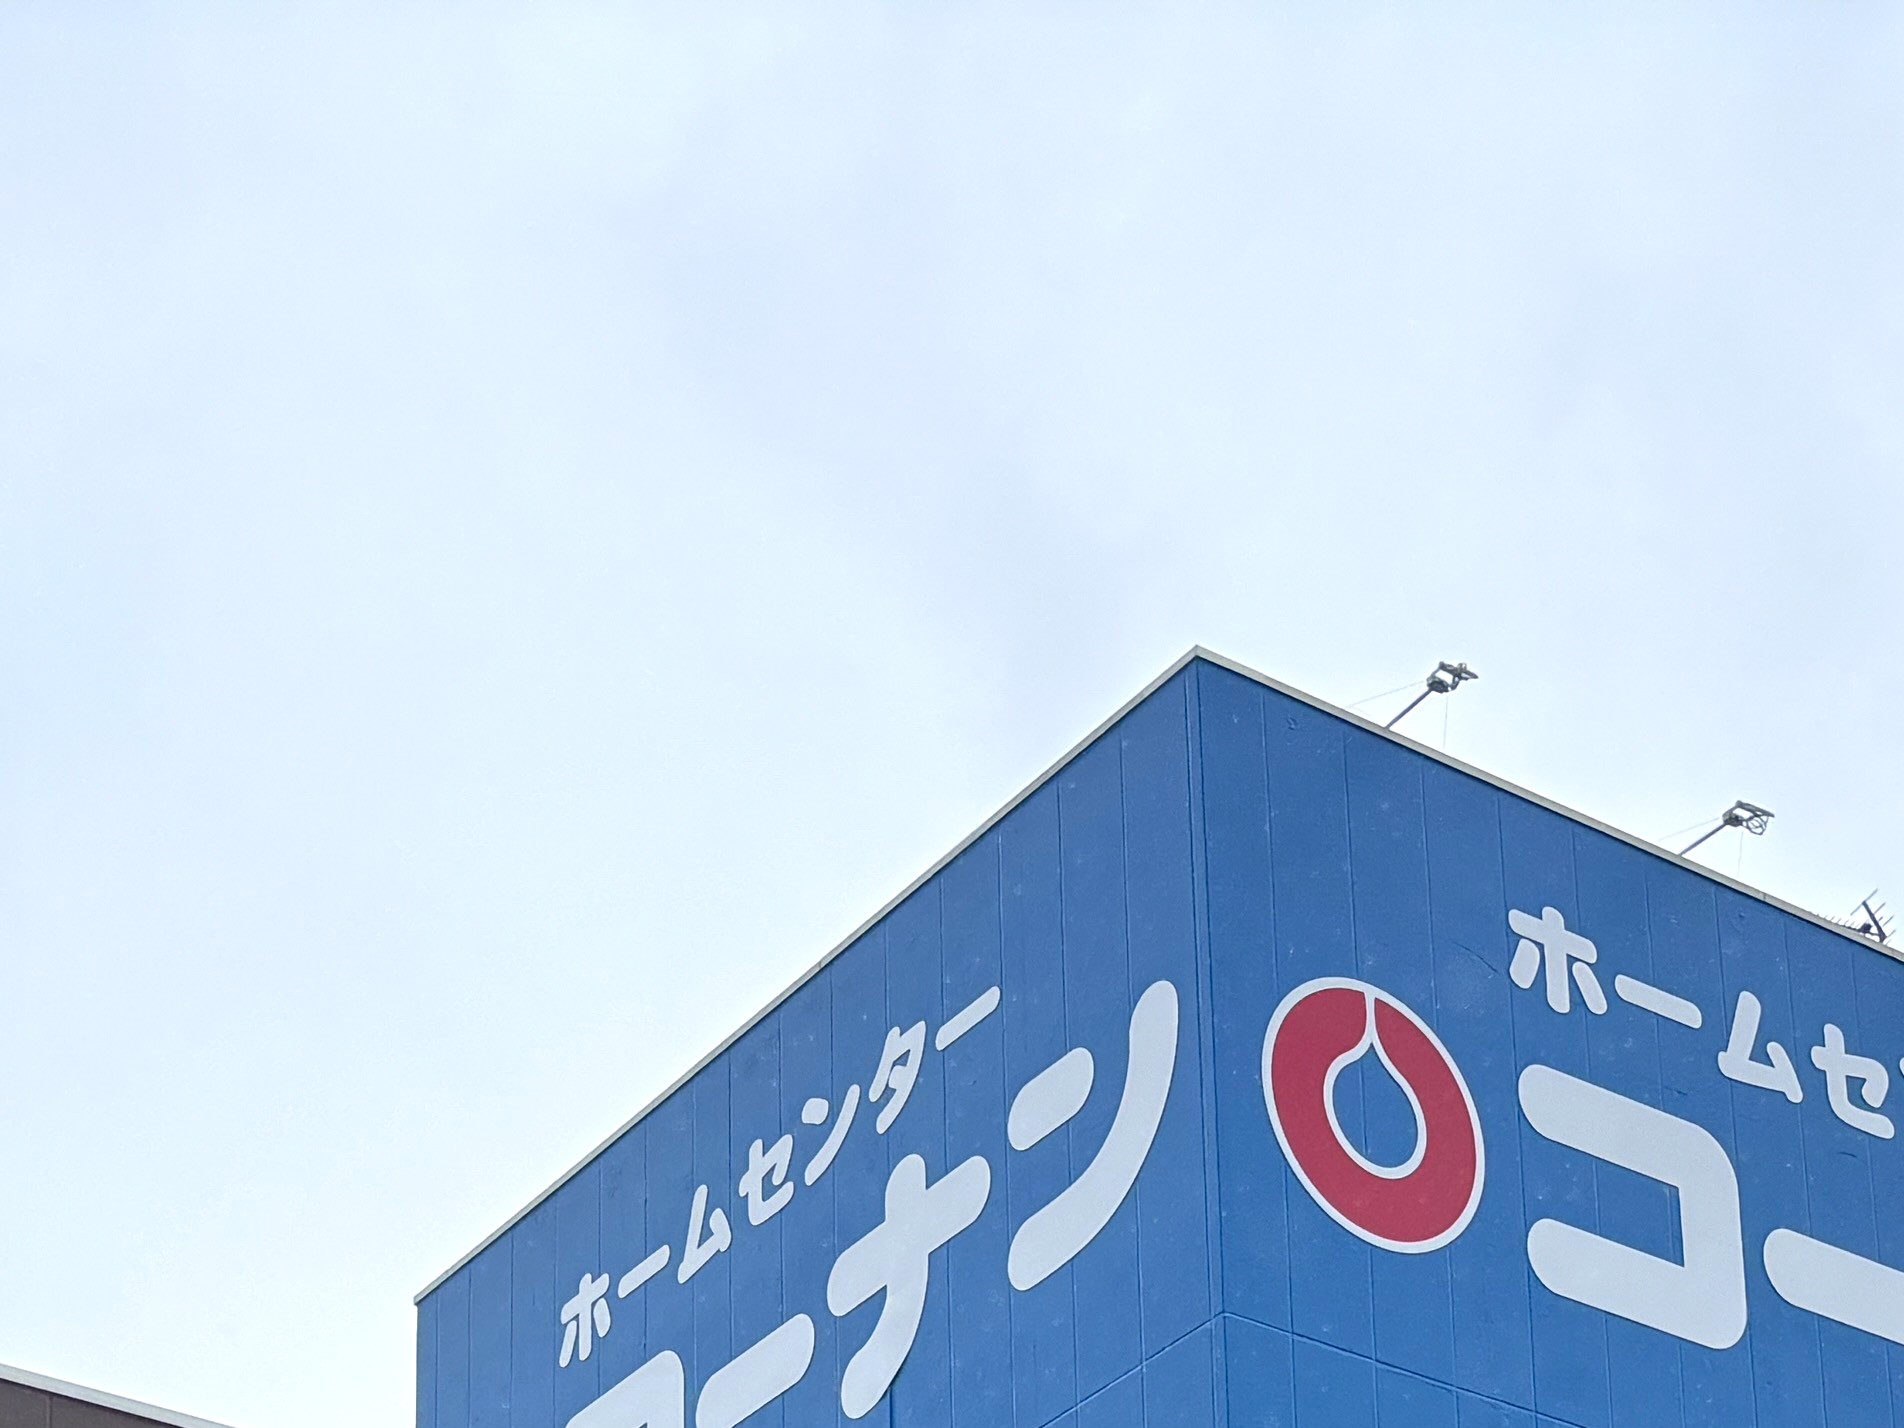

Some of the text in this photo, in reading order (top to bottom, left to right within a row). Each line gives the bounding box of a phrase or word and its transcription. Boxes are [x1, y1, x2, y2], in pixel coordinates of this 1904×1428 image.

[557, 987, 1003, 1368] ホームセンター
